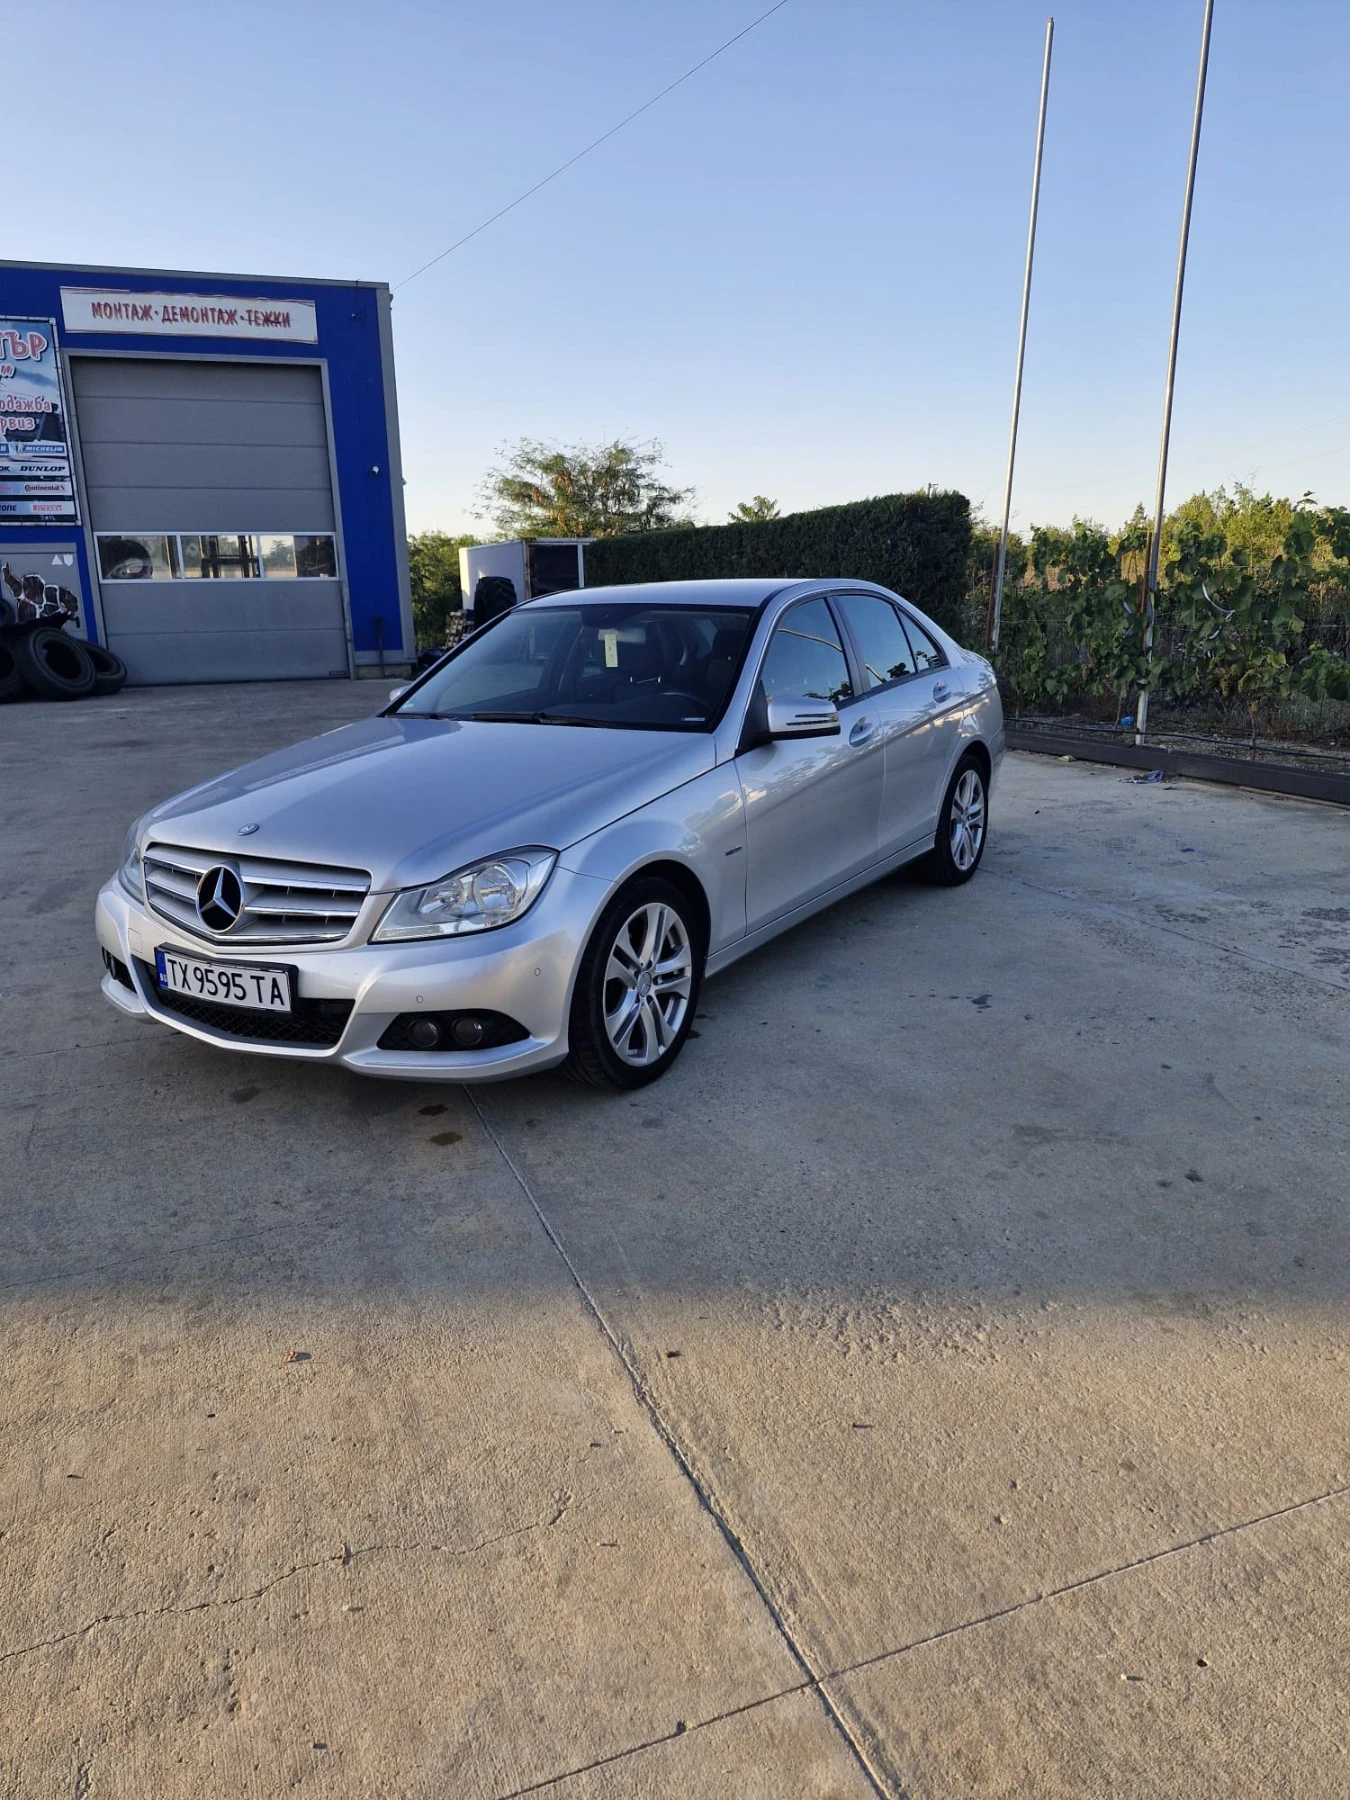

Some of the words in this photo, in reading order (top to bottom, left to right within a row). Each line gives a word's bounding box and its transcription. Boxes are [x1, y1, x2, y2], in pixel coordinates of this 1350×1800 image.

[91, 301, 153, 322] МОНТАЖ
[161, 305, 239, 325] ДЕМОНТАЖ
[245, 309, 292, 328] ТЕЖКИ
[25, 484, 60, 492] Continental
